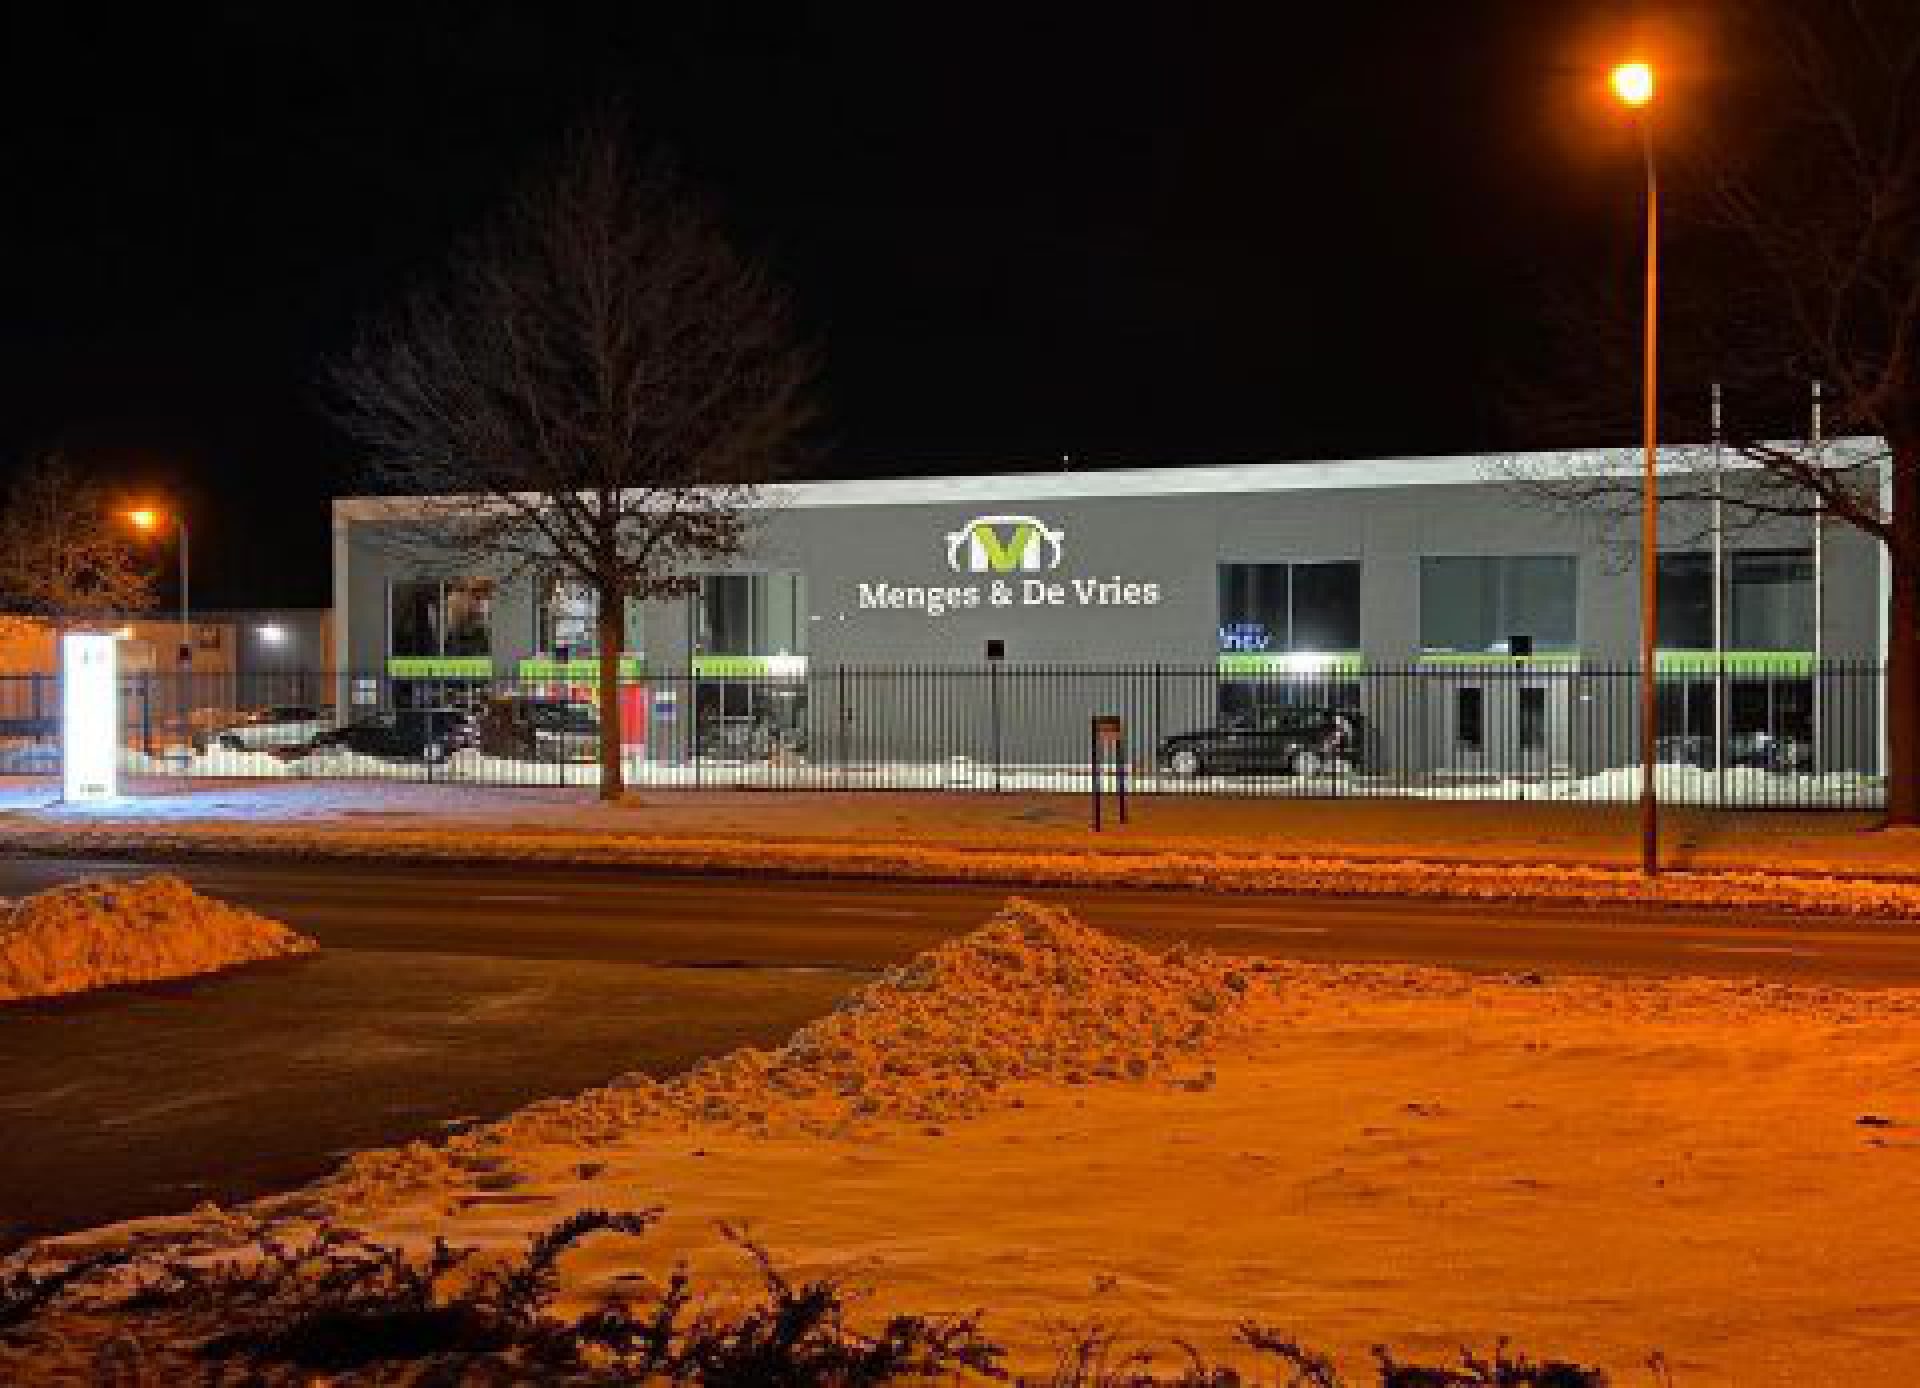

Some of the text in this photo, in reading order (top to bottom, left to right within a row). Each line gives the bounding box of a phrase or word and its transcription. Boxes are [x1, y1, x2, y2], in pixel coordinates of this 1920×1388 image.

[857, 576, 1162, 616] Menges & De Vries
